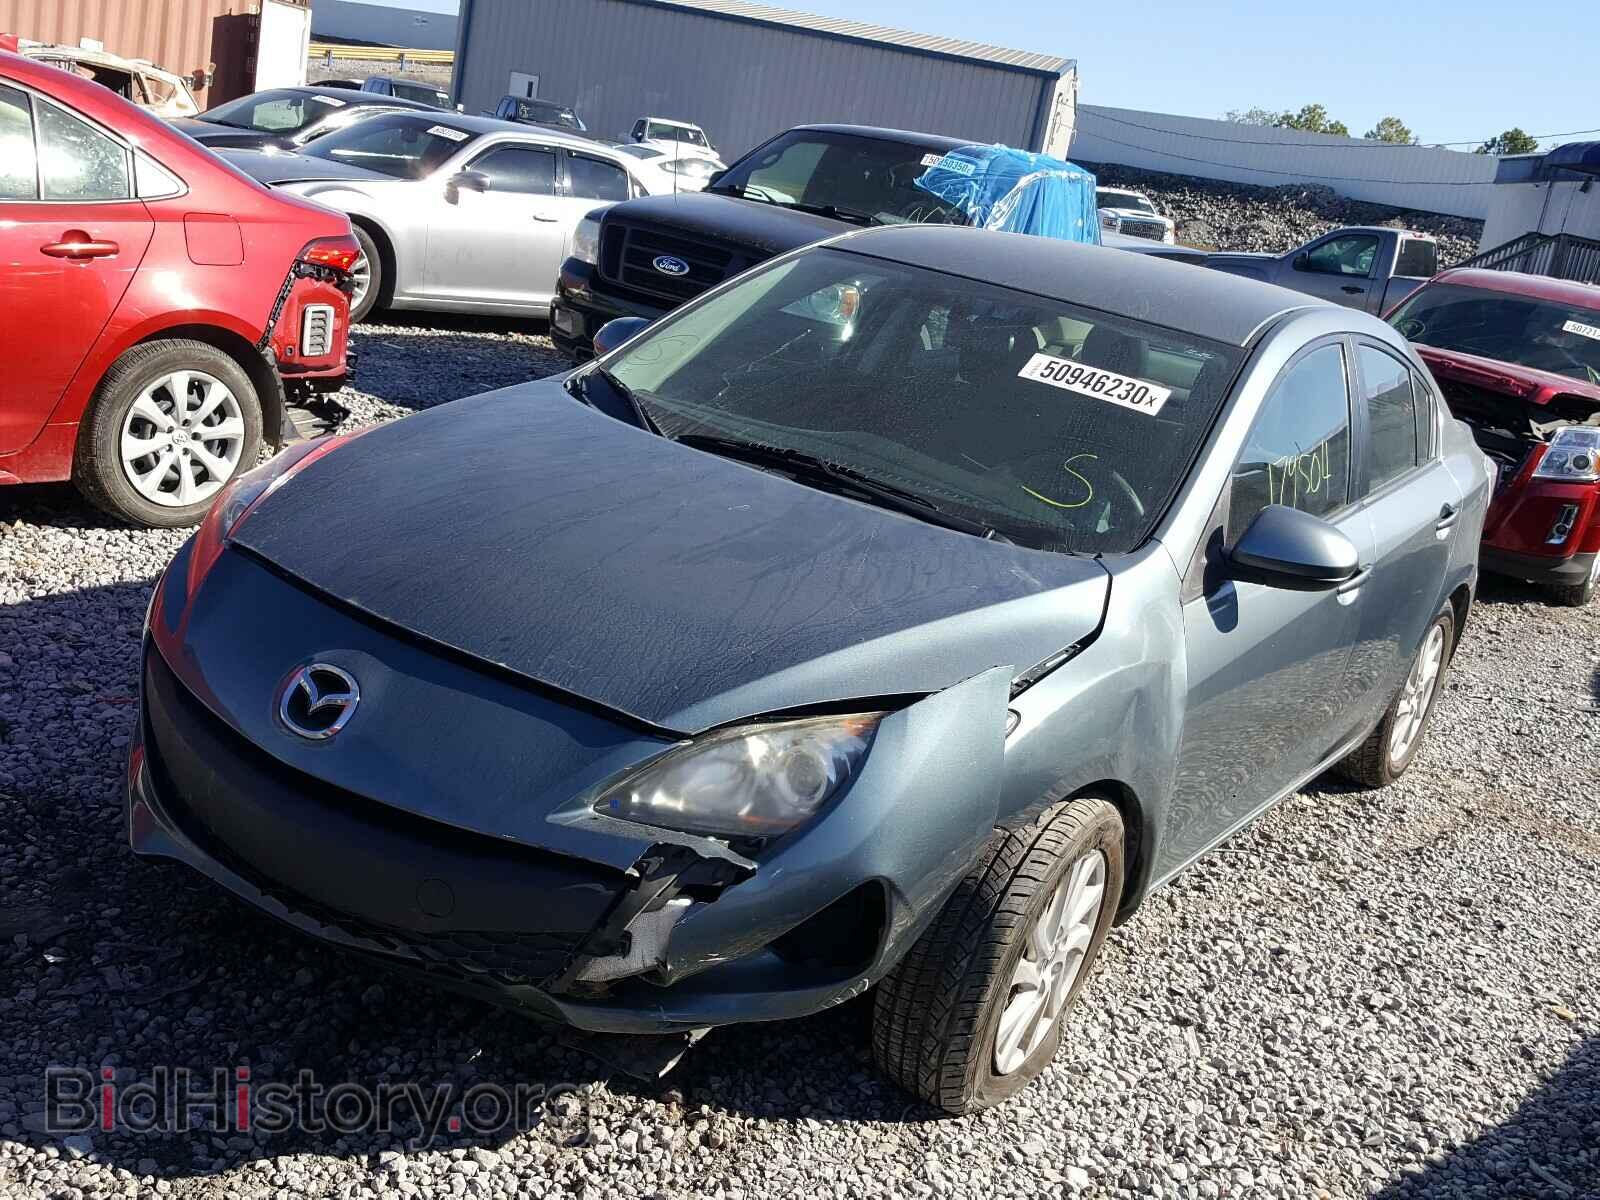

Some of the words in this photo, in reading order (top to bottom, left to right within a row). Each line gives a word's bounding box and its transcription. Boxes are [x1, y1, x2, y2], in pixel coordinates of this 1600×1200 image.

[660, 258, 681, 271] Ford
[1570, 323, 1600, 338] 50721
[1022, 453, 1098, 508] S
